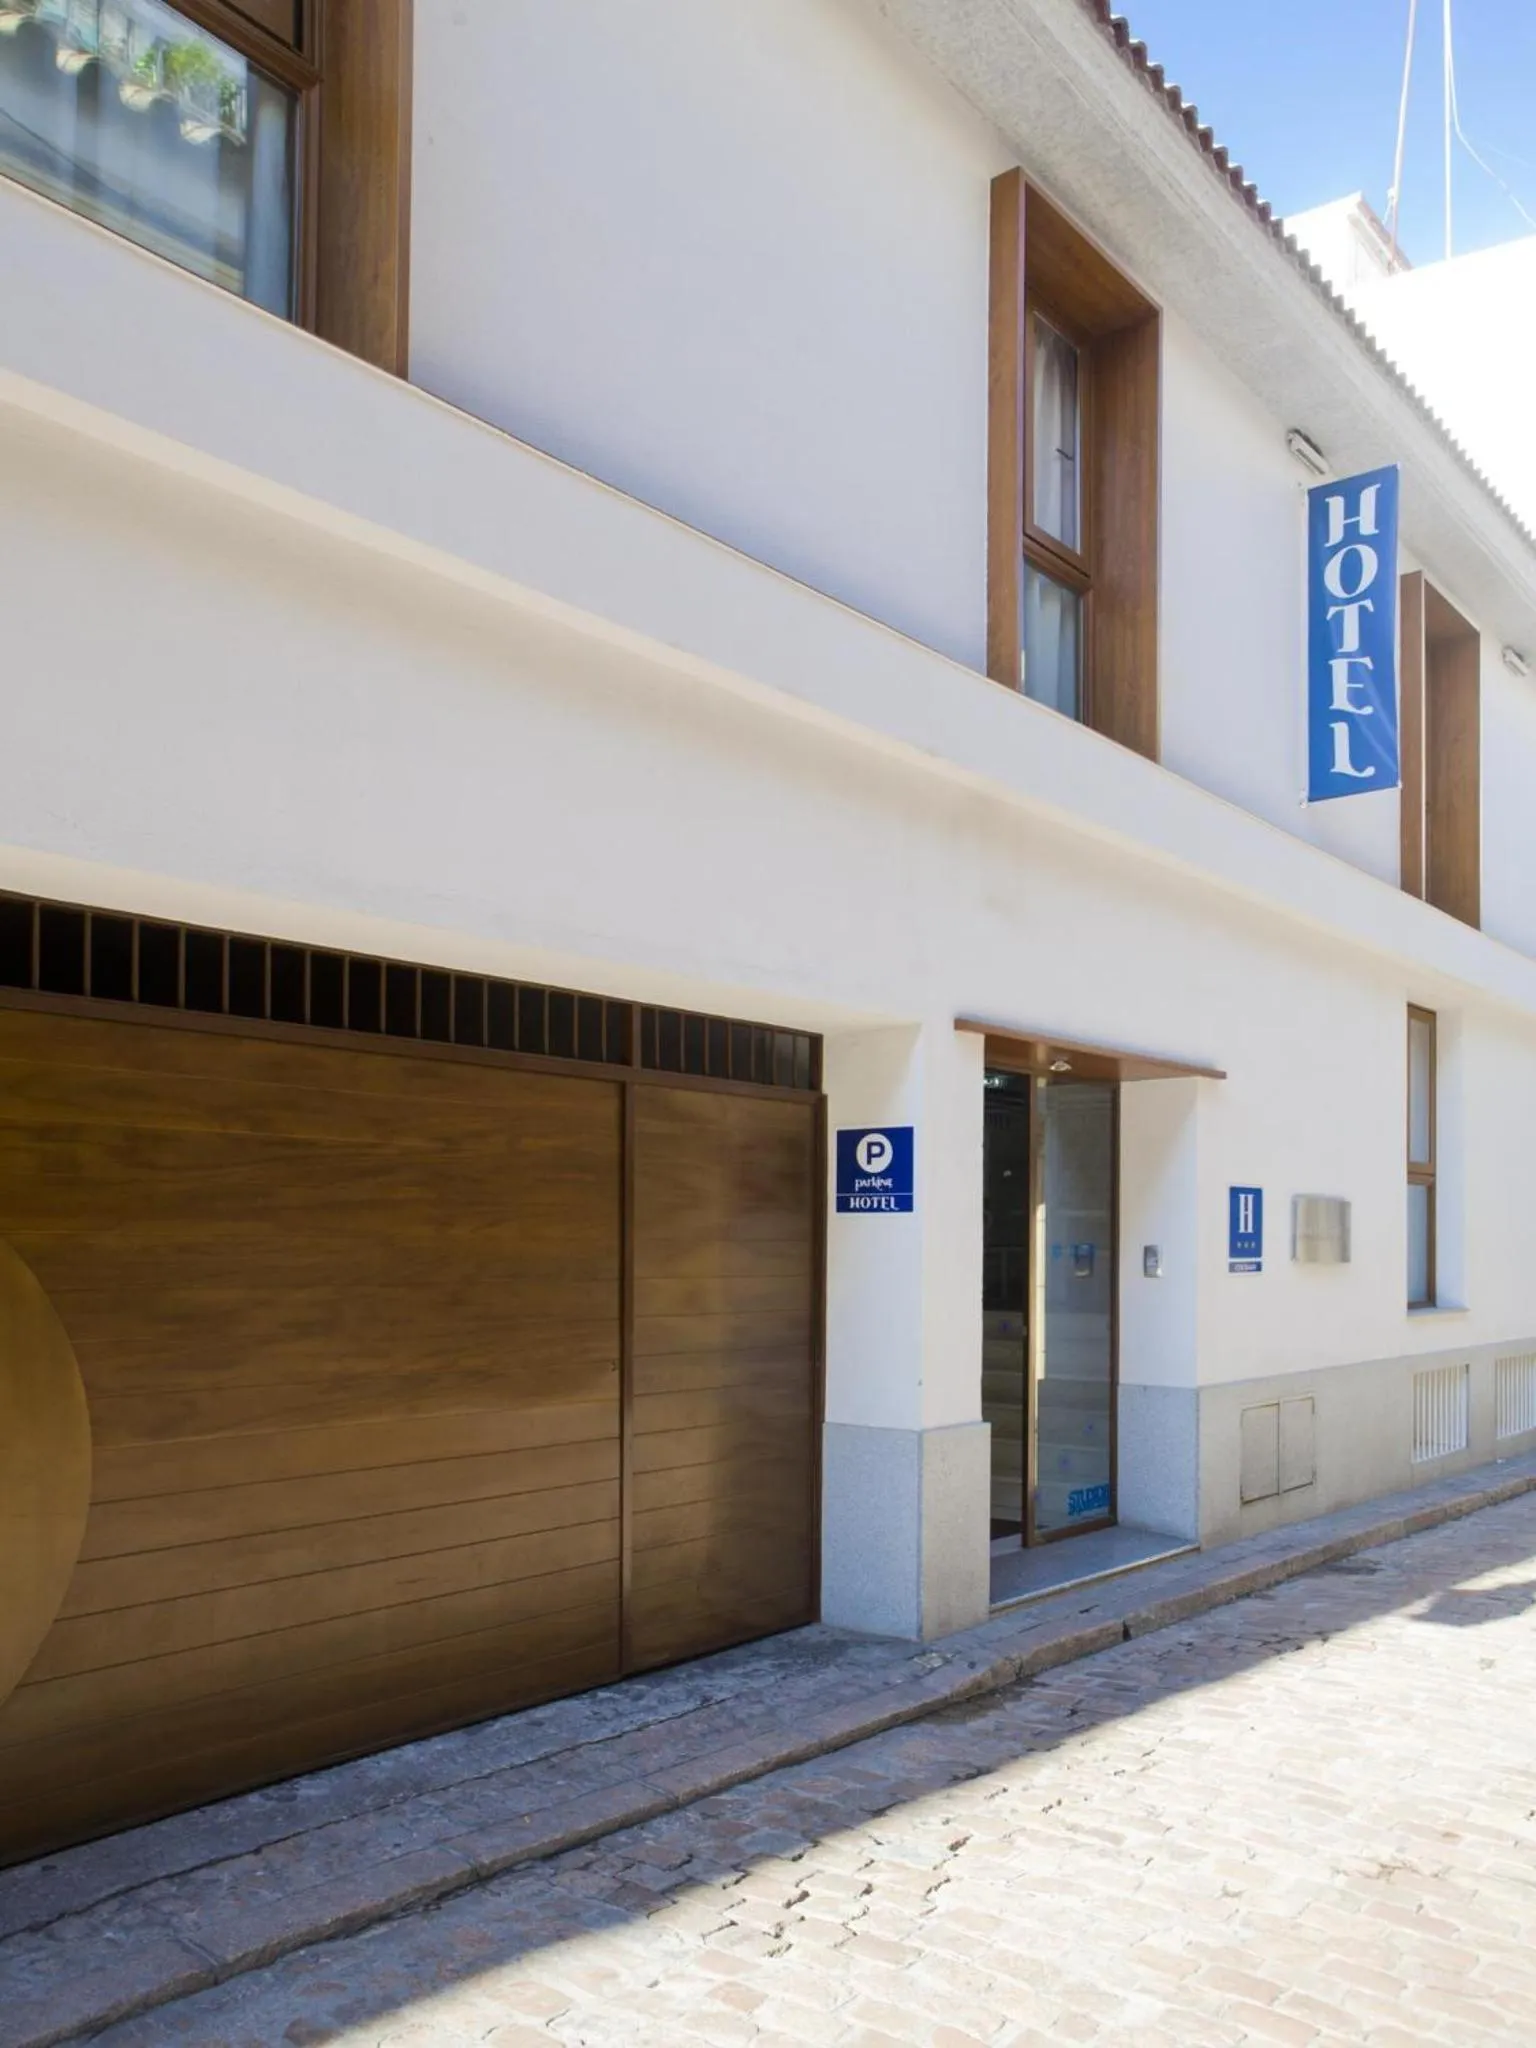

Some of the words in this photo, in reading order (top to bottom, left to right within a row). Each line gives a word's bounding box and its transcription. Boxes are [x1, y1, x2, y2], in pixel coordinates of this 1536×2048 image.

[1323, 483, 1381, 779] HOTEL
[866, 1141, 886, 1165] P
[849, 1196, 900, 1211] HOTEL
[1238, 1194, 1255, 1233] H
